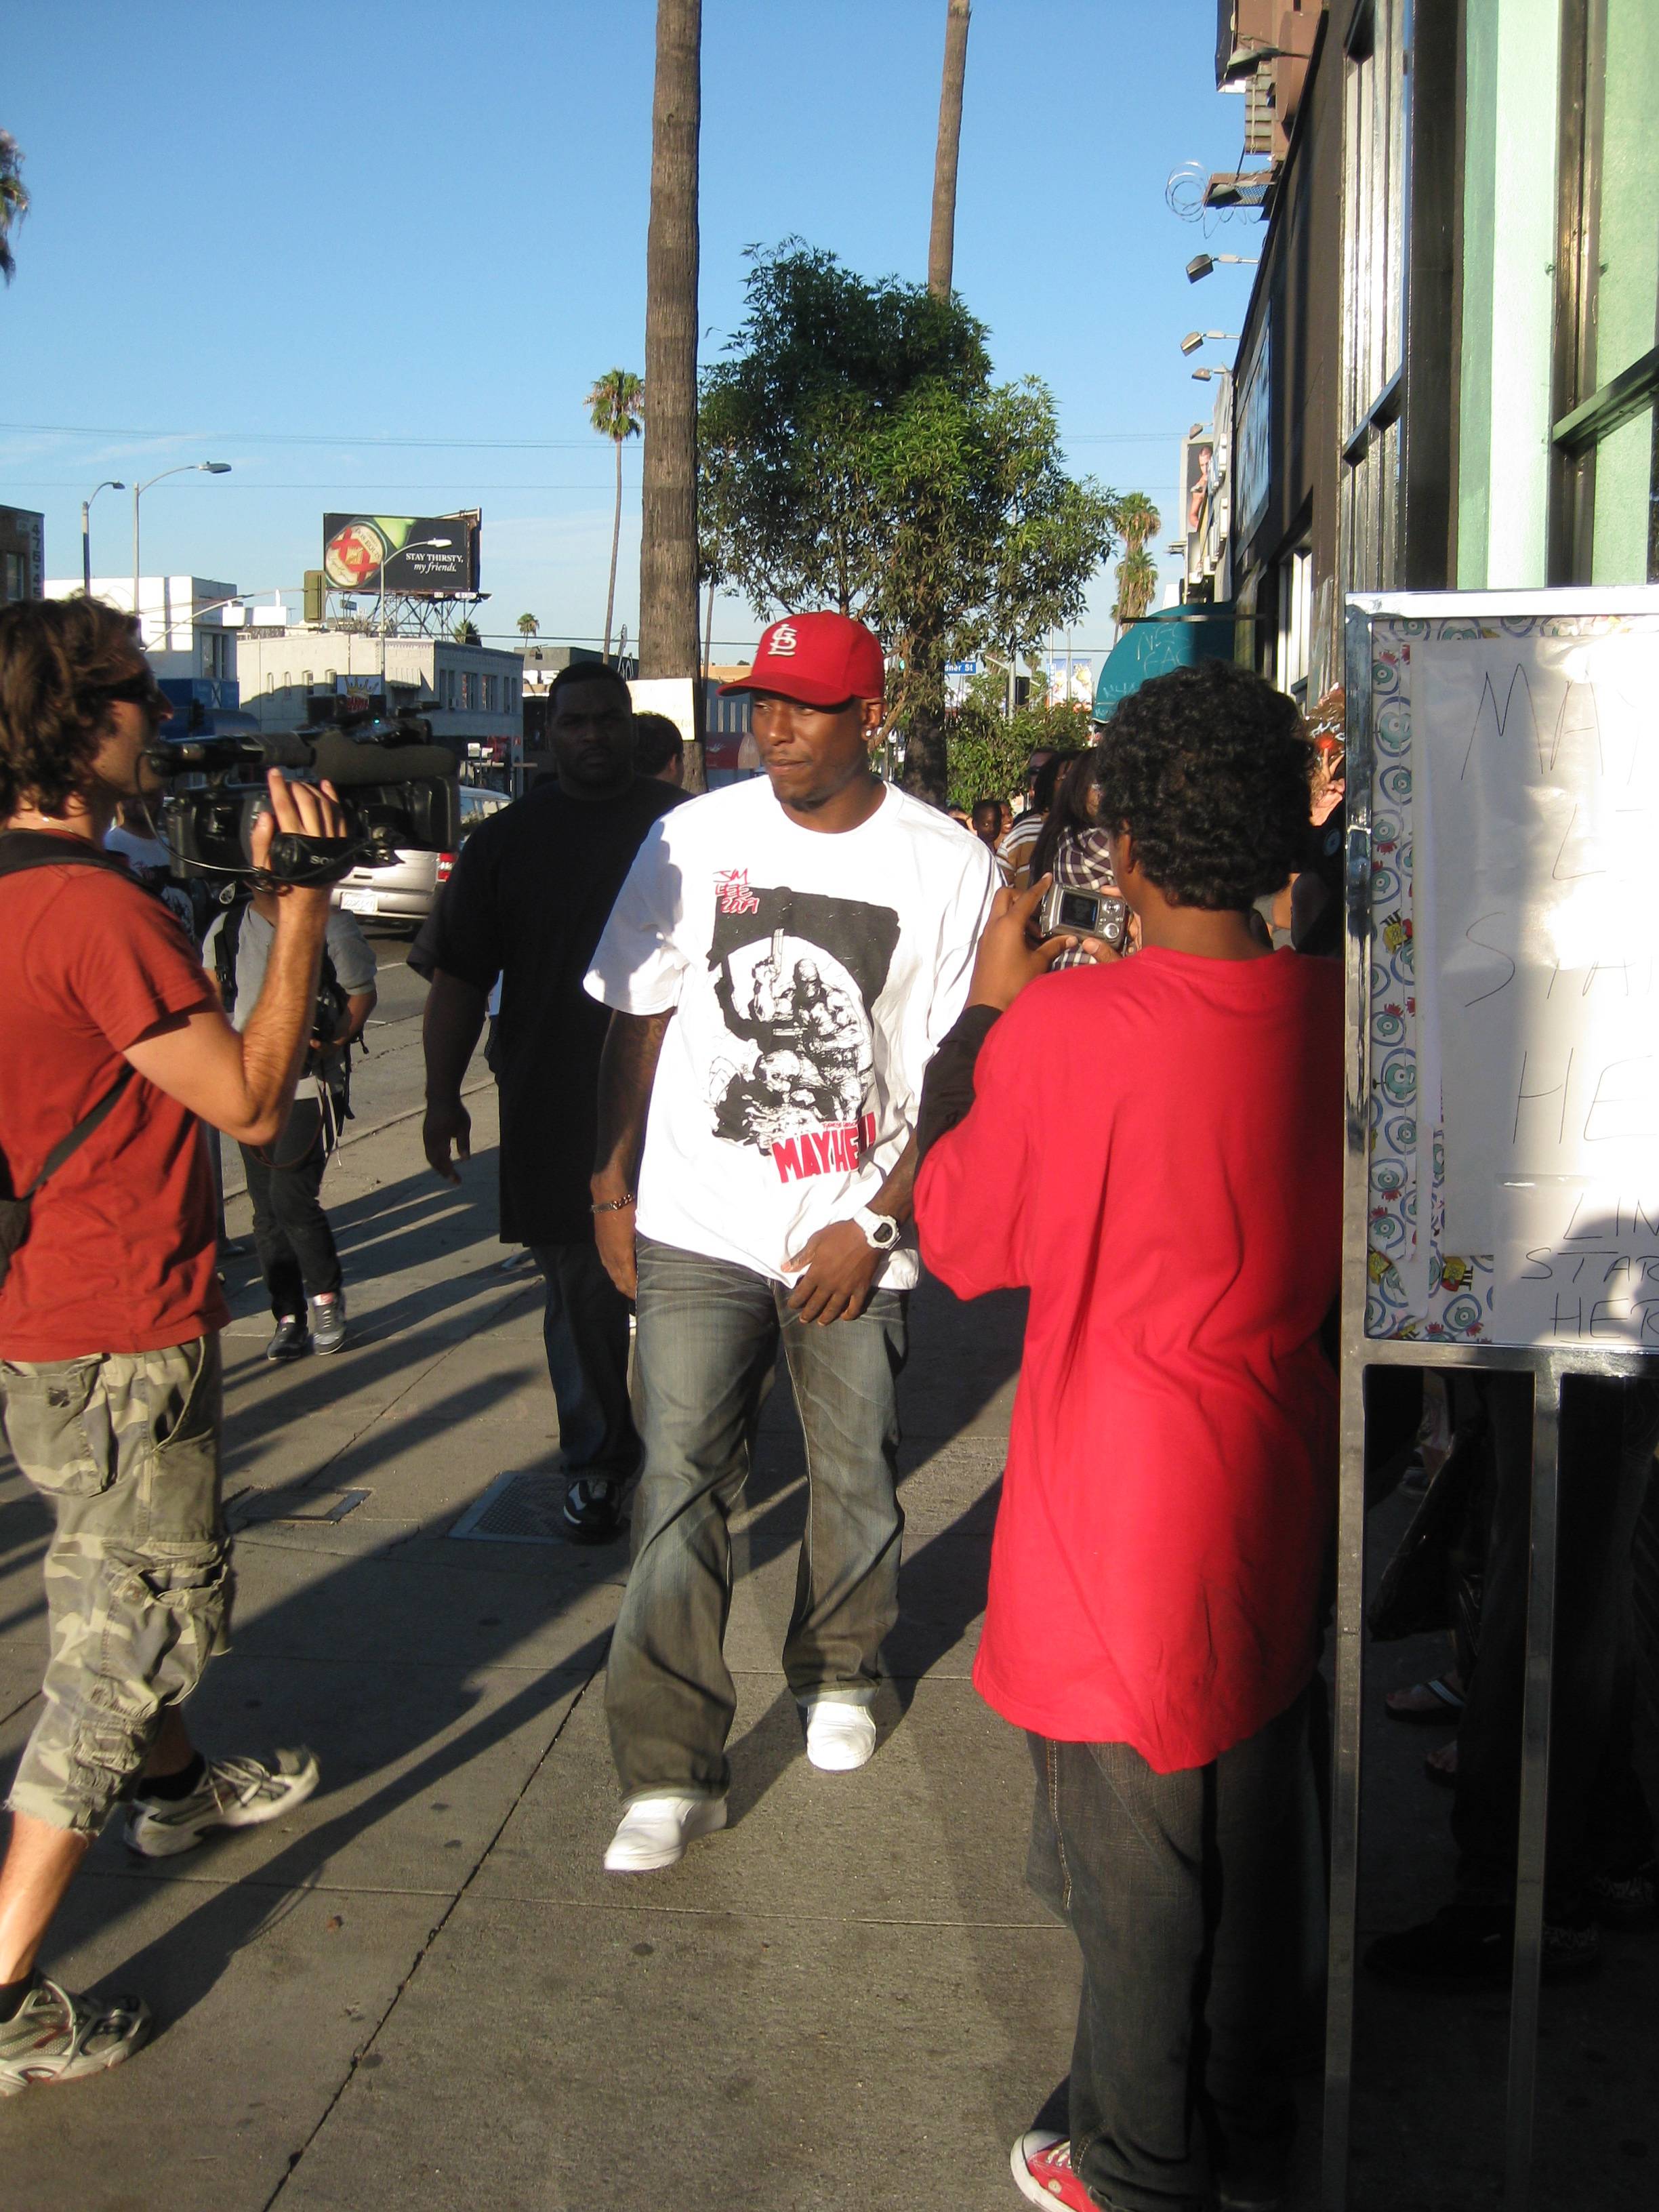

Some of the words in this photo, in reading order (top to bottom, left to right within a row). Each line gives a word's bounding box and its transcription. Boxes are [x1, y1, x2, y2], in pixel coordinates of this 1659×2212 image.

[405, 552, 425, 562] STAY
[427, 553, 464, 564] THIRSTY,
[413, 563, 426, 574] my
[425, 562, 457, 573] friends.
[945, 663, 962, 672] dner
[964, 663, 974, 672] St
[721, 897, 760, 915] 2009
